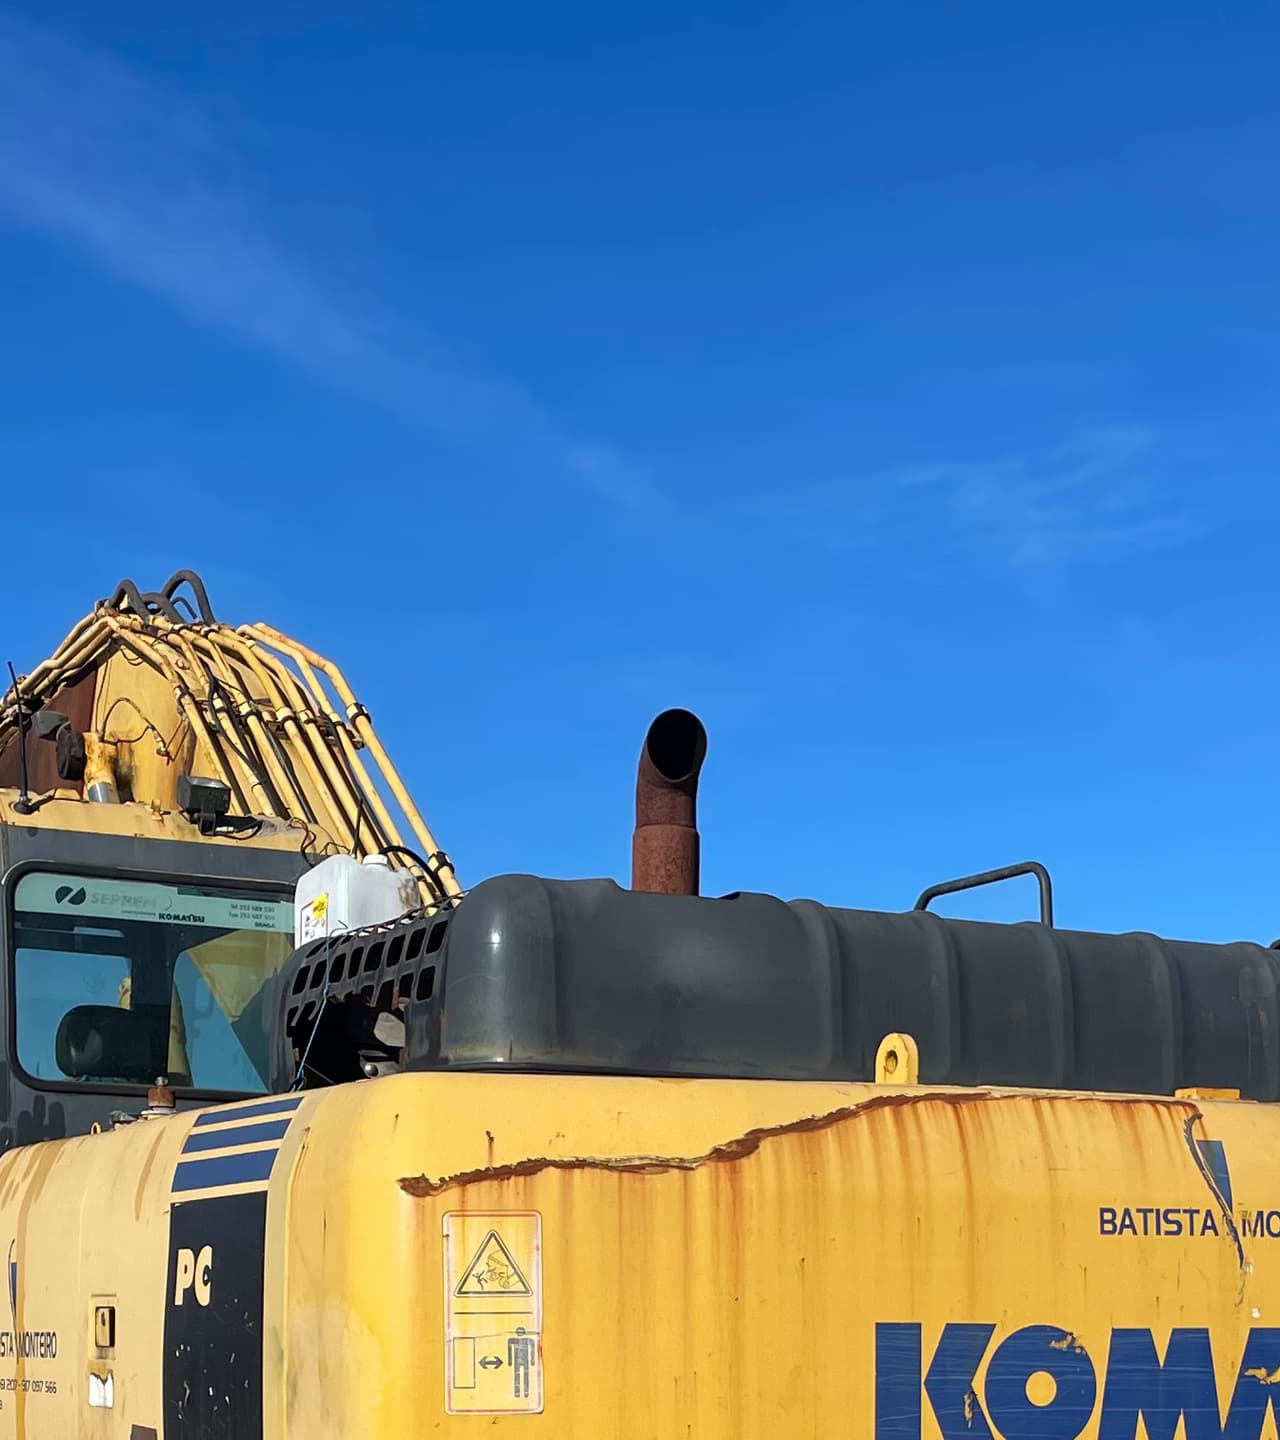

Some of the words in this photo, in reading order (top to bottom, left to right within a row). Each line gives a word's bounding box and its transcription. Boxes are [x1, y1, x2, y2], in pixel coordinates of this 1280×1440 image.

[158, 912, 205, 923] KOMATSU
[1099, 1207, 1219, 1237] BATISTA
[174, 1245, 213, 1307] PC
[17, 1330, 57, 1359] MONTEIRO
